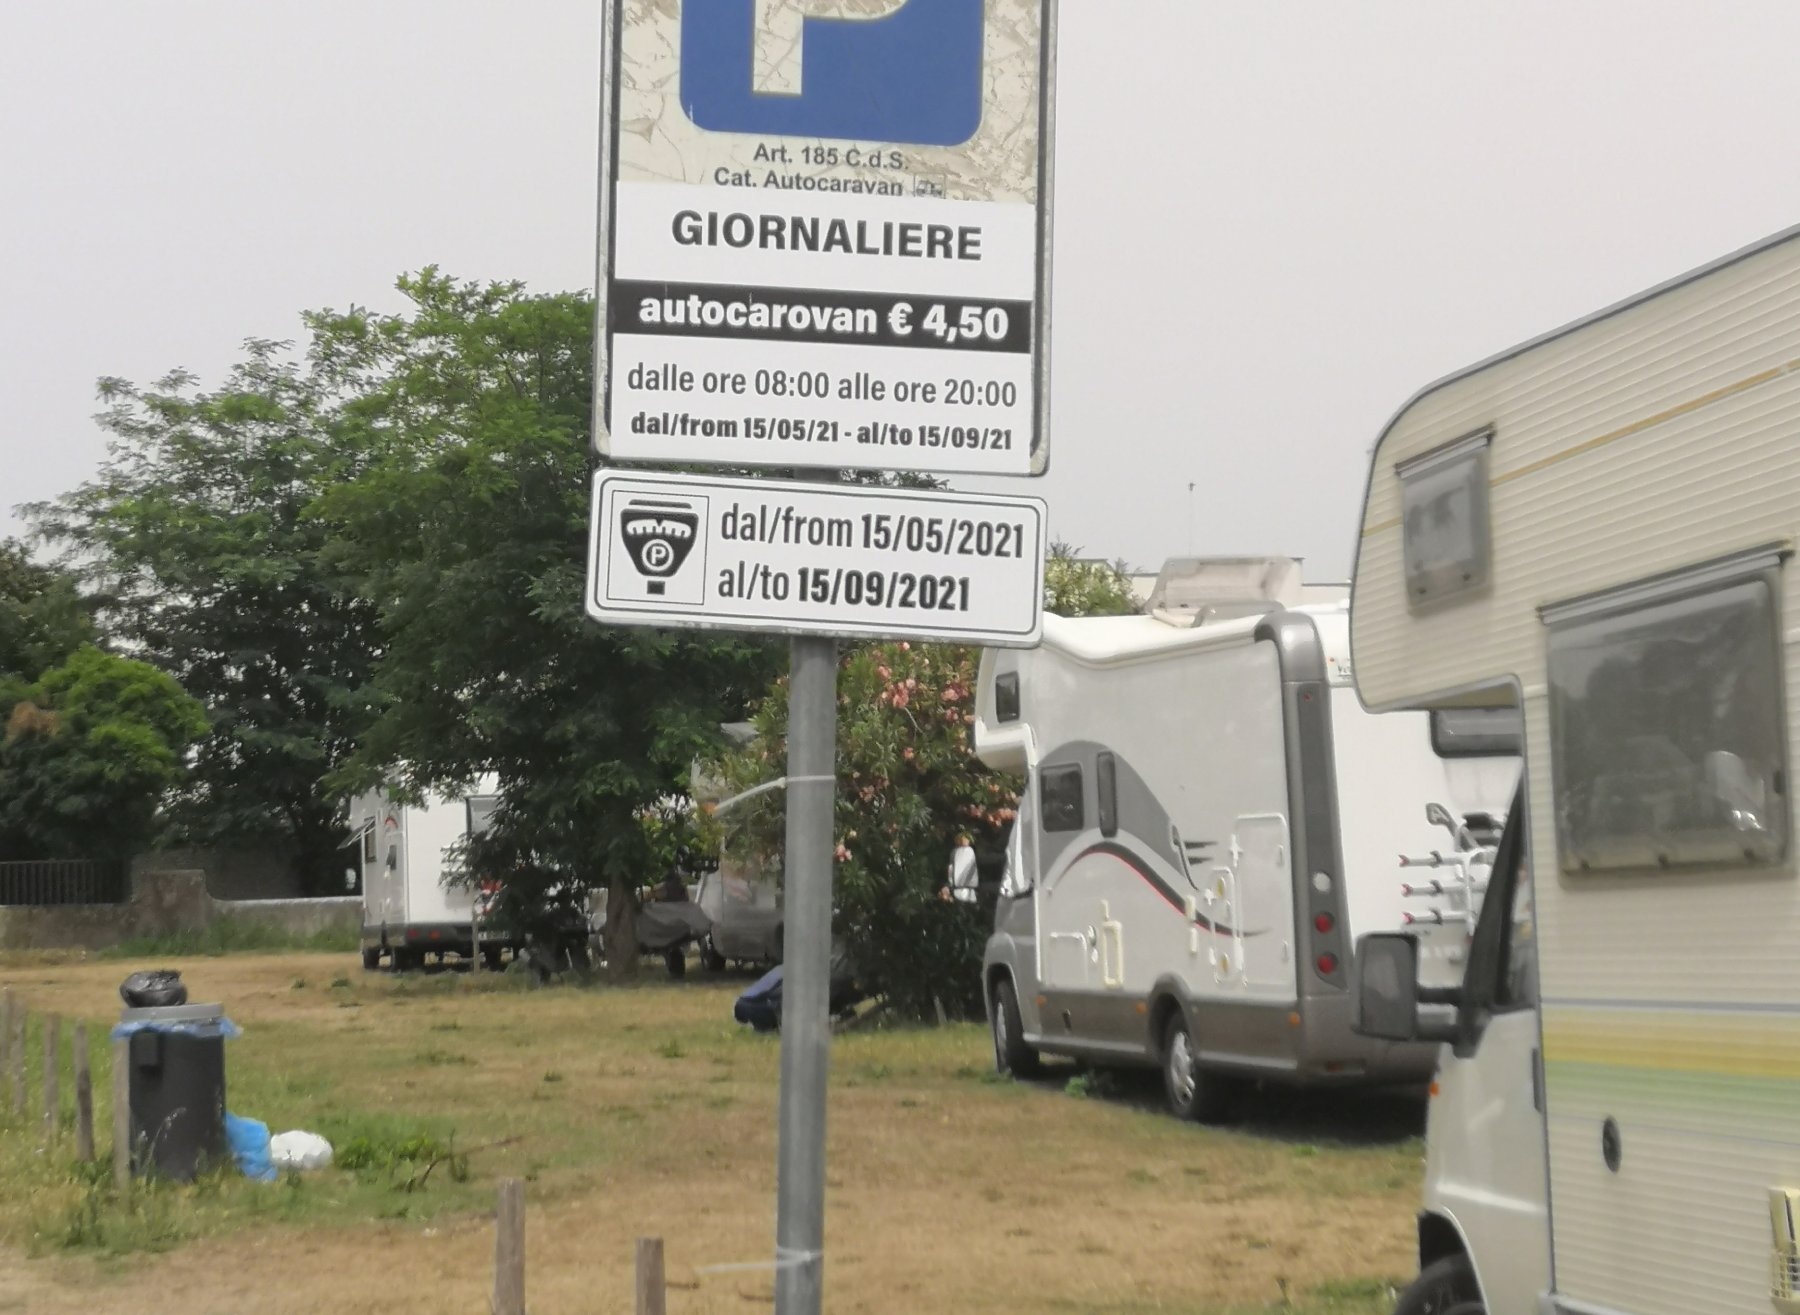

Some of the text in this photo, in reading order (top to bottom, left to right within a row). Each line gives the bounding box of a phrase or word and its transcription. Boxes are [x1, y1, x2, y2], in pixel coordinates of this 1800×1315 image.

[754, 143, 909, 170] Art. 185 C.d.S.
[714, 167, 903, 196] Cat. Autocaravan
[672, 210, 982, 261] GIORNALIERE
[639, 294, 1009, 341] autocarovan € 4,50
[627, 362, 1017, 407] dalle ore 08:00 alle ore 20:00
[631, 412, 738, 438] dal/from
[744, 417, 838, 443] 15/05/21
[857, 422, 913, 446] al/to
[919, 425, 1012, 450] 15/09/21
[721, 503, 1023, 558] dal/from 15/05/2021
[718, 561, 969, 612] al/to 15/09/2021
